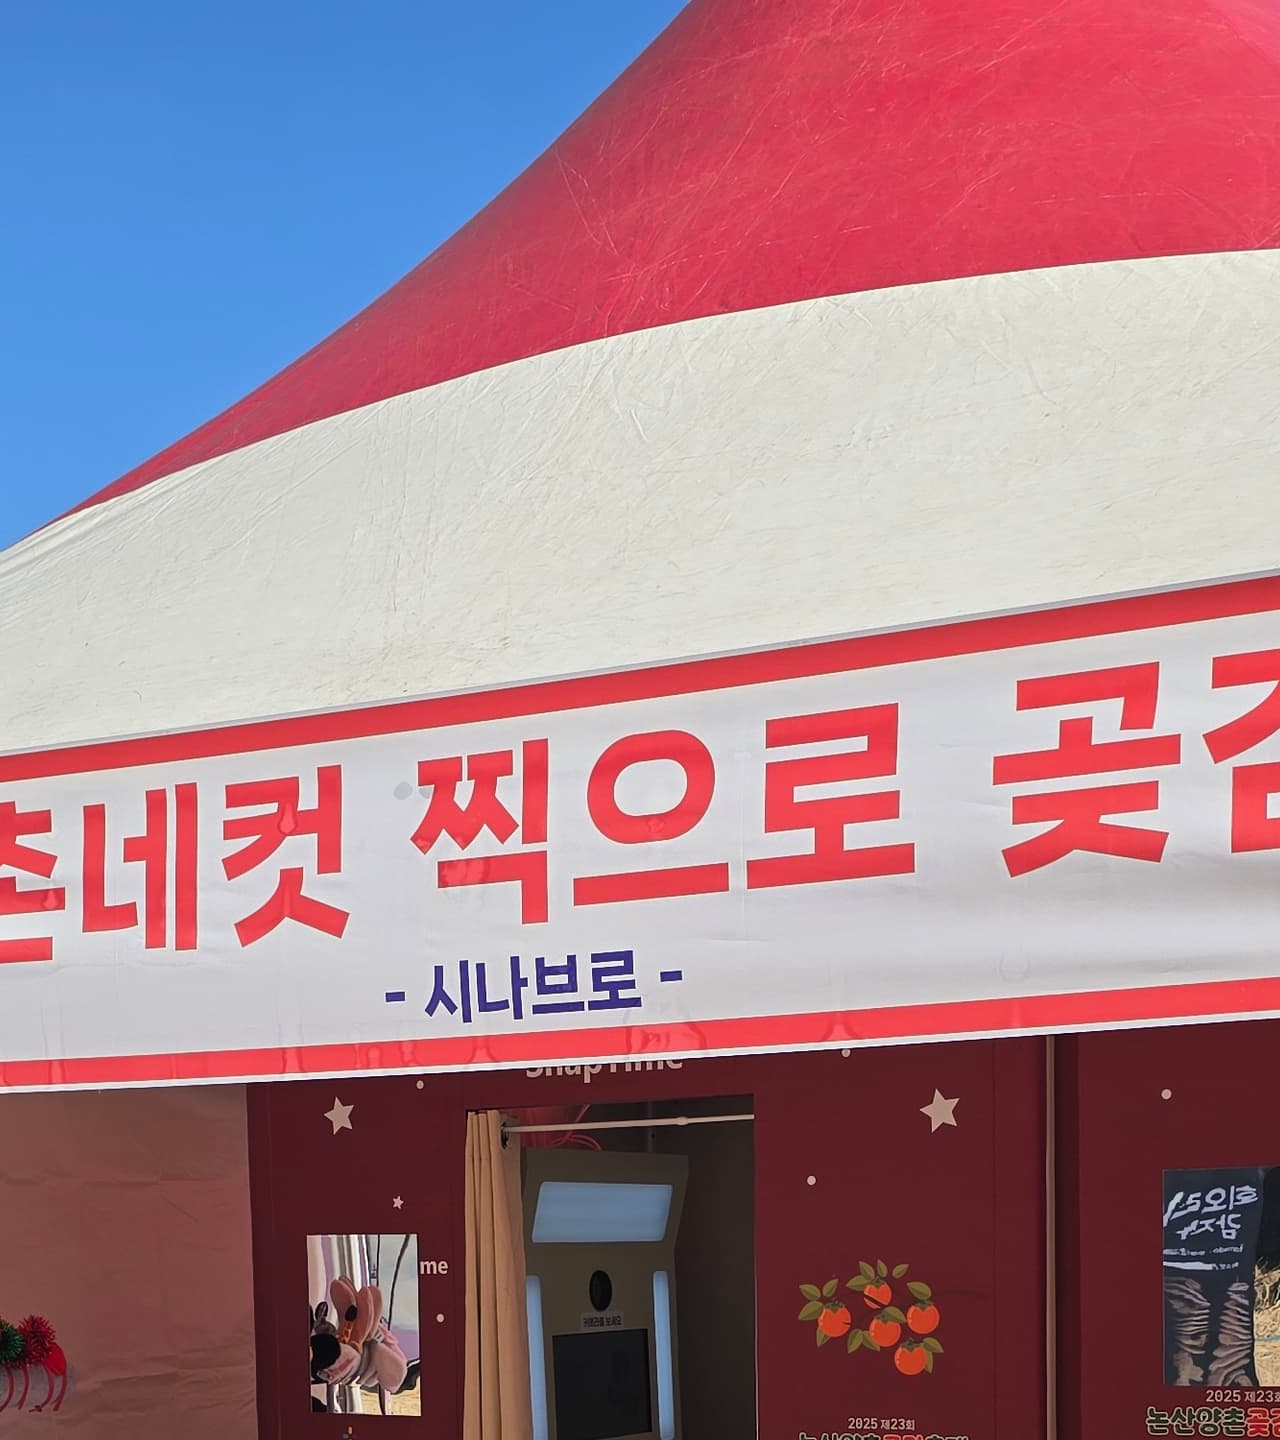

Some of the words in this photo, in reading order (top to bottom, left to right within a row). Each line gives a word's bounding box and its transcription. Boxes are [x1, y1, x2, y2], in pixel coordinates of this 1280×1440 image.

[410, 702, 915, 924] 찍으로
[424, 950, 642, 1023] 시나브로
[1206, 1389, 1241, 1403] 2025
[848, 1417, 878, 1430] 2025
[880, 1418, 915, 1431] 제23회
